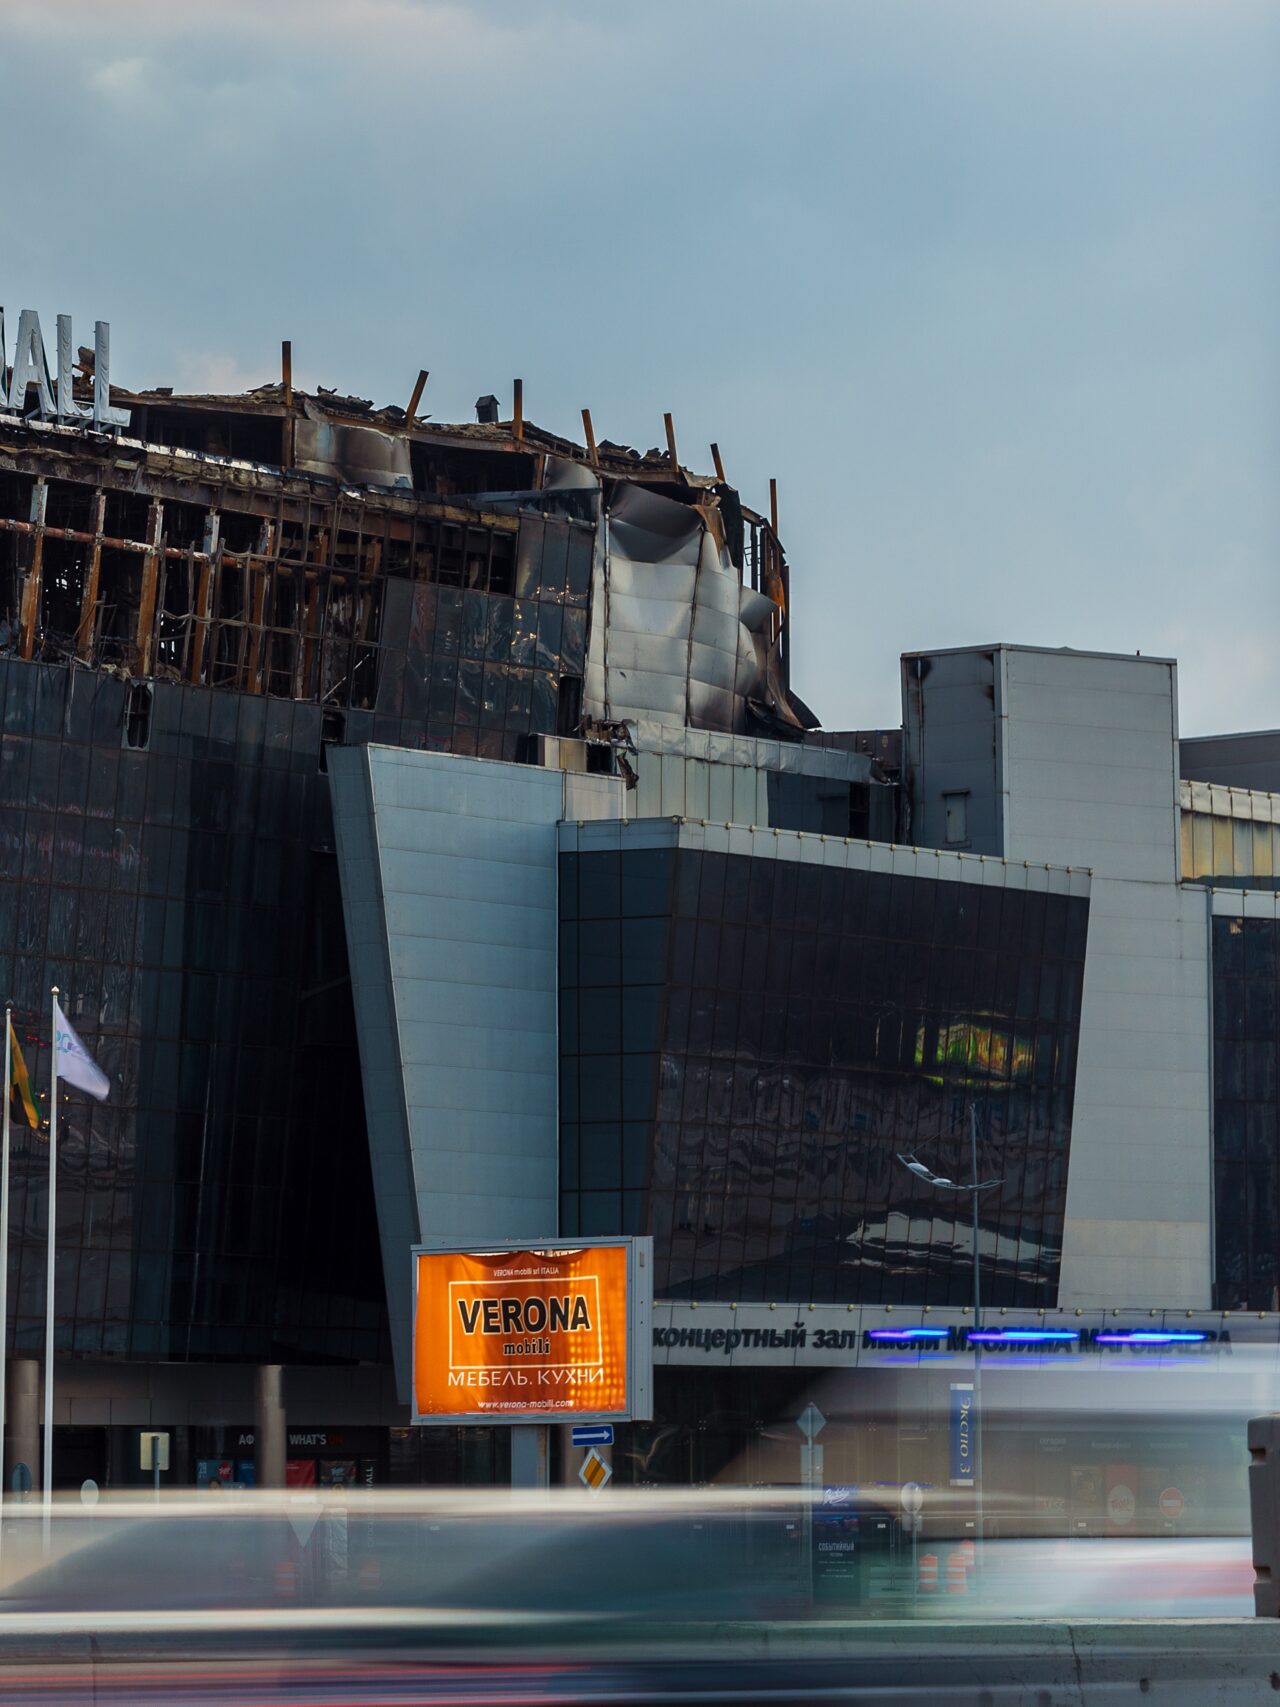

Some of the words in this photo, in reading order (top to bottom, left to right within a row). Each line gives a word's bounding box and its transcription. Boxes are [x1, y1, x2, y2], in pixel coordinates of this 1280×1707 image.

[457, 1294, 592, 1336] VERONA
[503, 1337, 551, 1355] mobili
[653, 1322, 808, 1354] концертный
[813, 1329, 856, 1349] зал
[448, 1370, 533, 1387] МЕБЕЛЬ.
[537, 1368, 604, 1385] КУХНИ
[478, 1399, 573, 1409] www.verona-mobili.com
[289, 1434, 327, 1445] WHAT'S
[960, 1463, 971, 1473] 3
